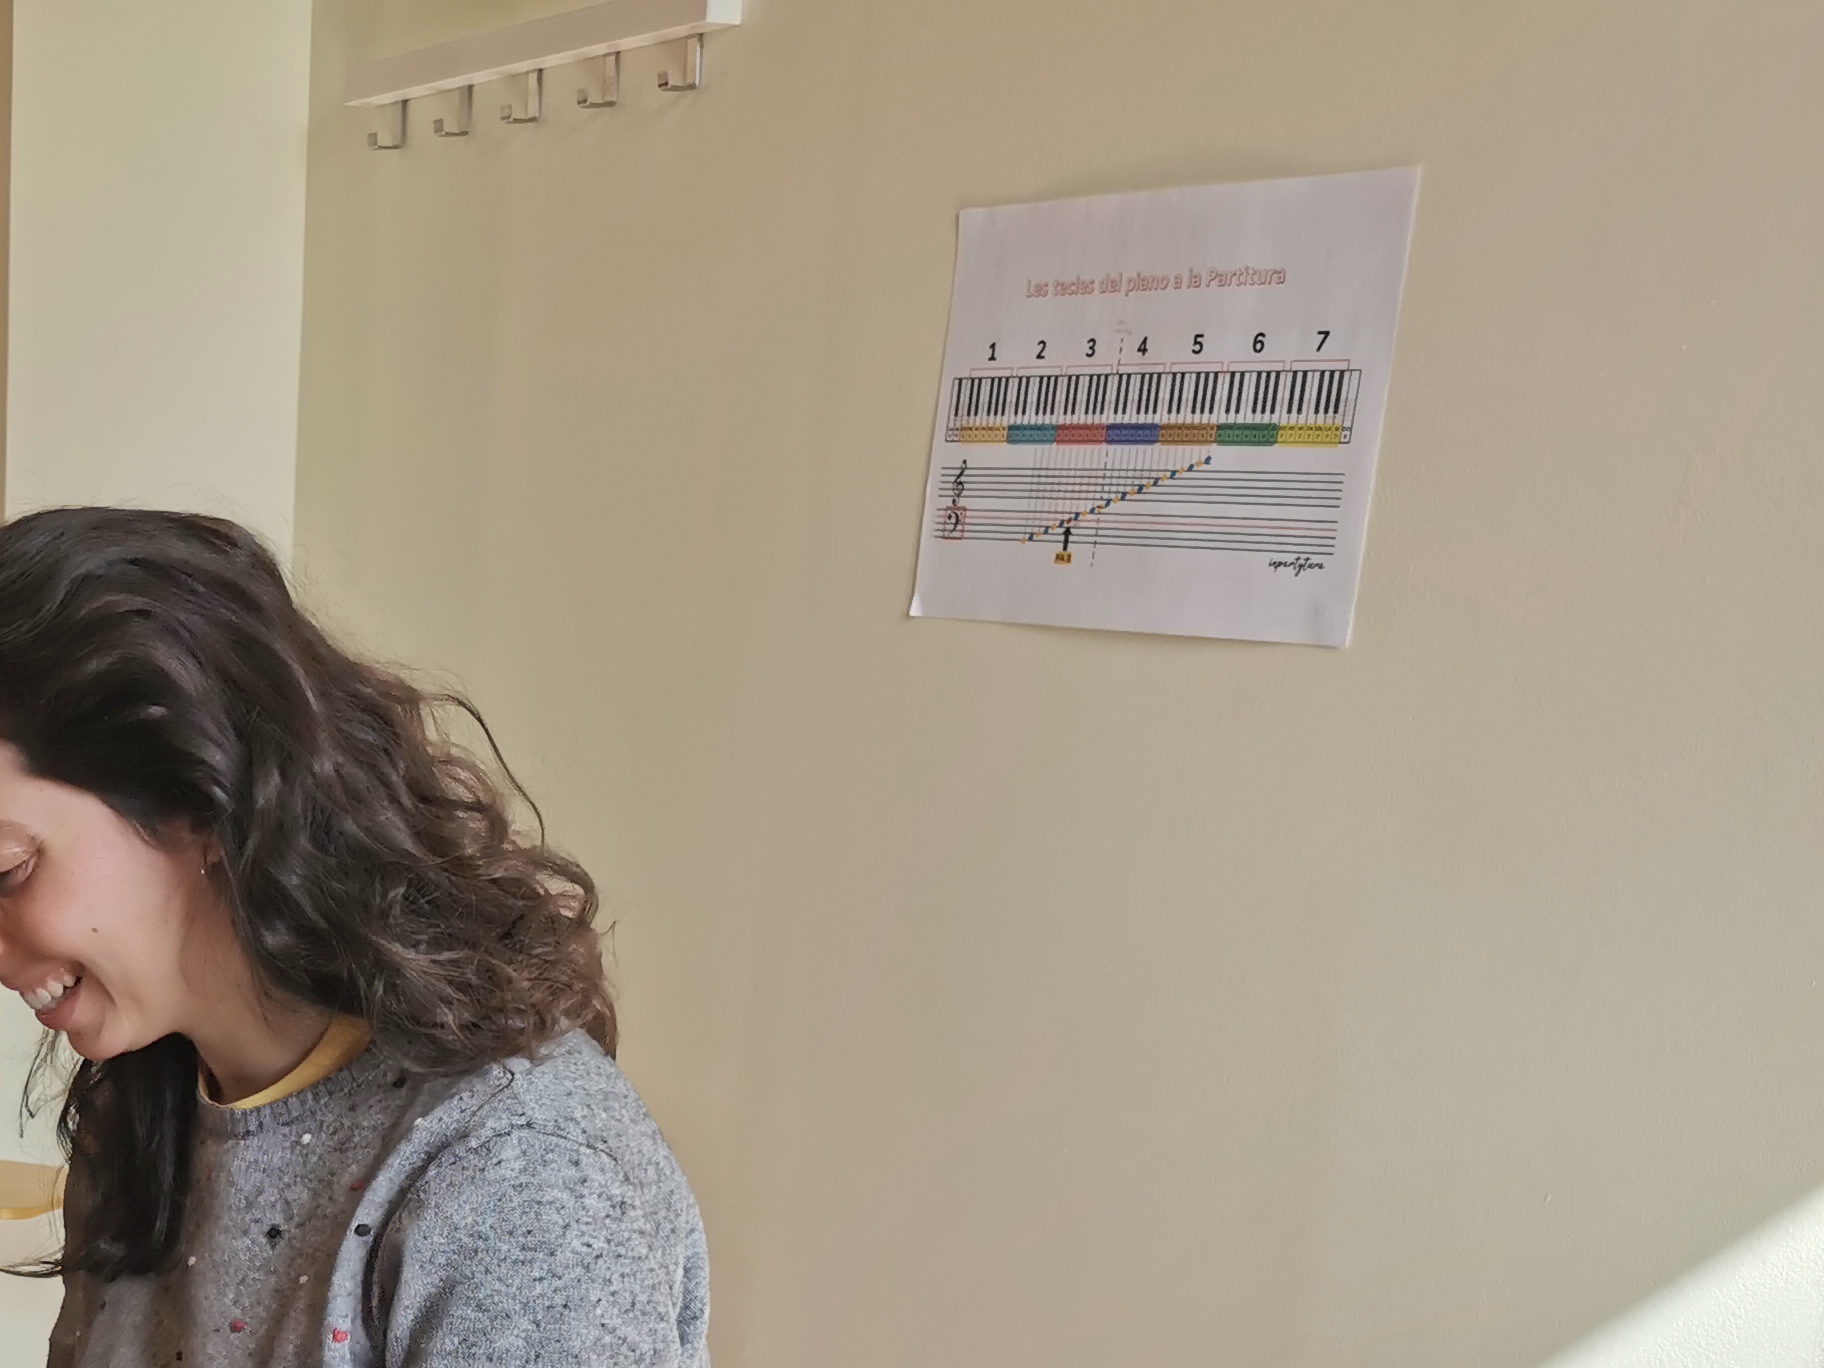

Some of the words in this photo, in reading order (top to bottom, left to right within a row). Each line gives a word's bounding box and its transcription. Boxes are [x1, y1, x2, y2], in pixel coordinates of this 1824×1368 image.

[1025, 279, 1049, 298] Les
[1052, 276, 1095, 297] tecles
[1098, 272, 1123, 295] del
[1125, 271, 1169, 296] piano
[1173, 273, 1183, 290] a
[1186, 268, 1202, 289] la
[1205, 265, 1287, 288] Partitura
[987, 342, 997, 361] 1
[1035, 340, 1047, 360] 2
[1085, 338, 1097, 358] 3
[1136, 336, 1149, 356] 4
[1191, 334, 1205, 355] 5
[1252, 332, 1267, 353] 6
[1315, 330, 1331, 352] 7
